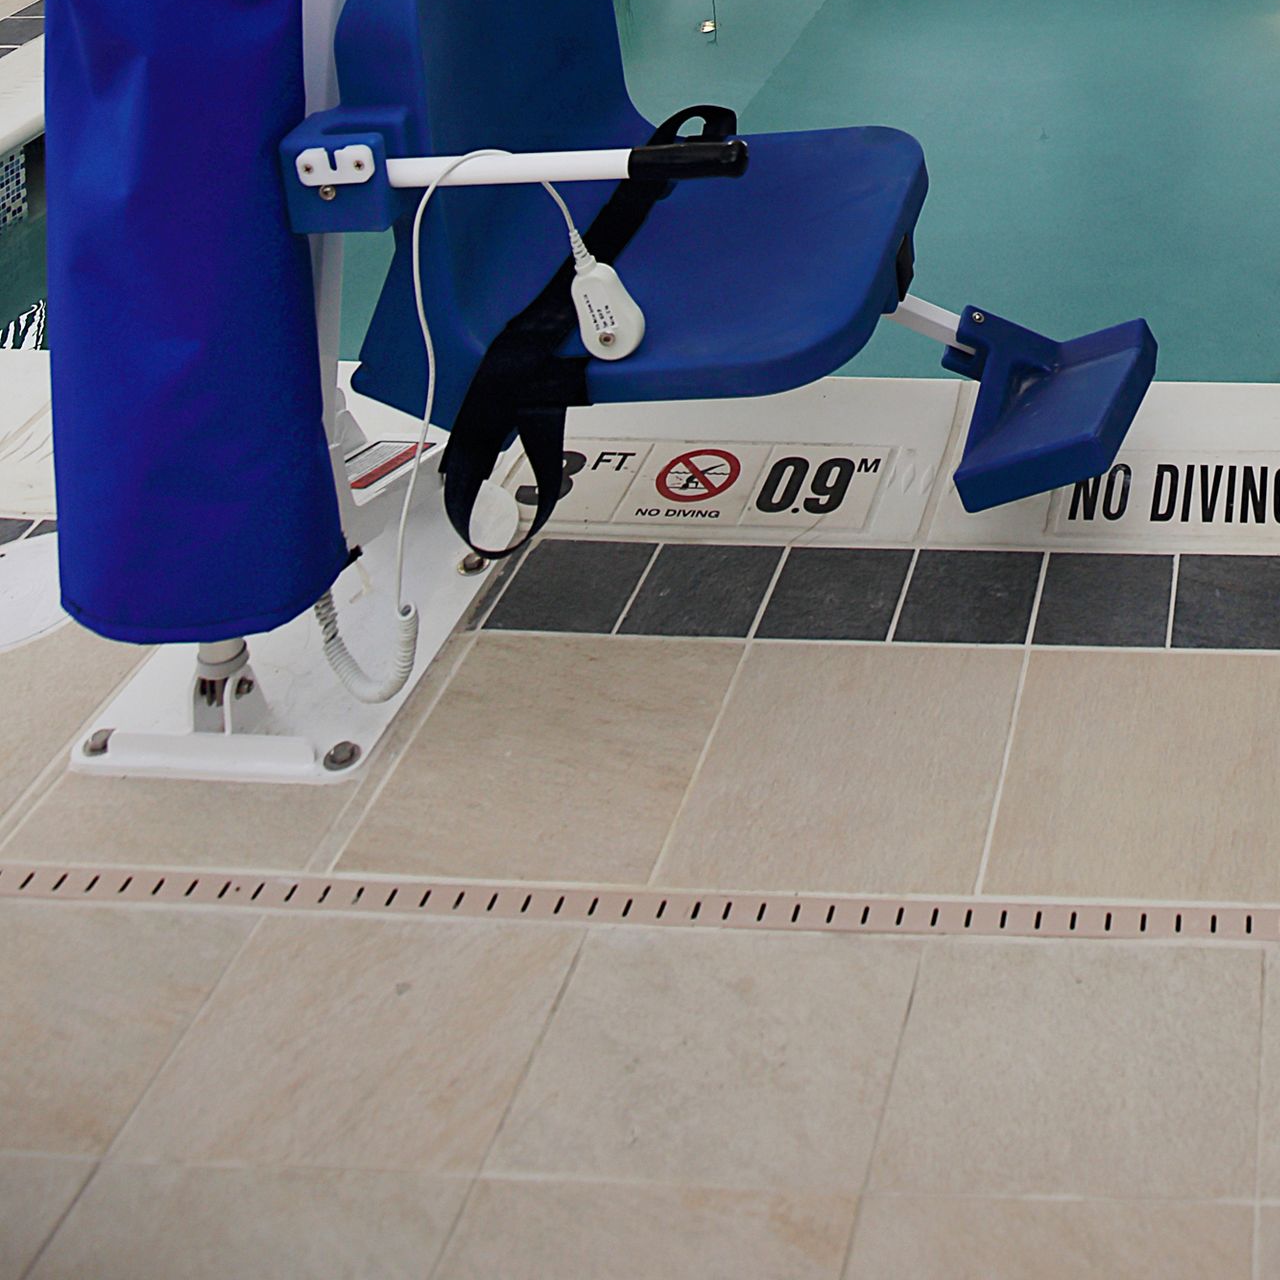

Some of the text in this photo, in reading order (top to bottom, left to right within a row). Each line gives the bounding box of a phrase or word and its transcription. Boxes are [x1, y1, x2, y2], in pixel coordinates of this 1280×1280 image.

[590, 452, 637, 472] FT
[755, 456, 856, 515] 0.9
[1068, 463, 1132, 521] NO
[635, 507, 721, 519] NO DIVING
